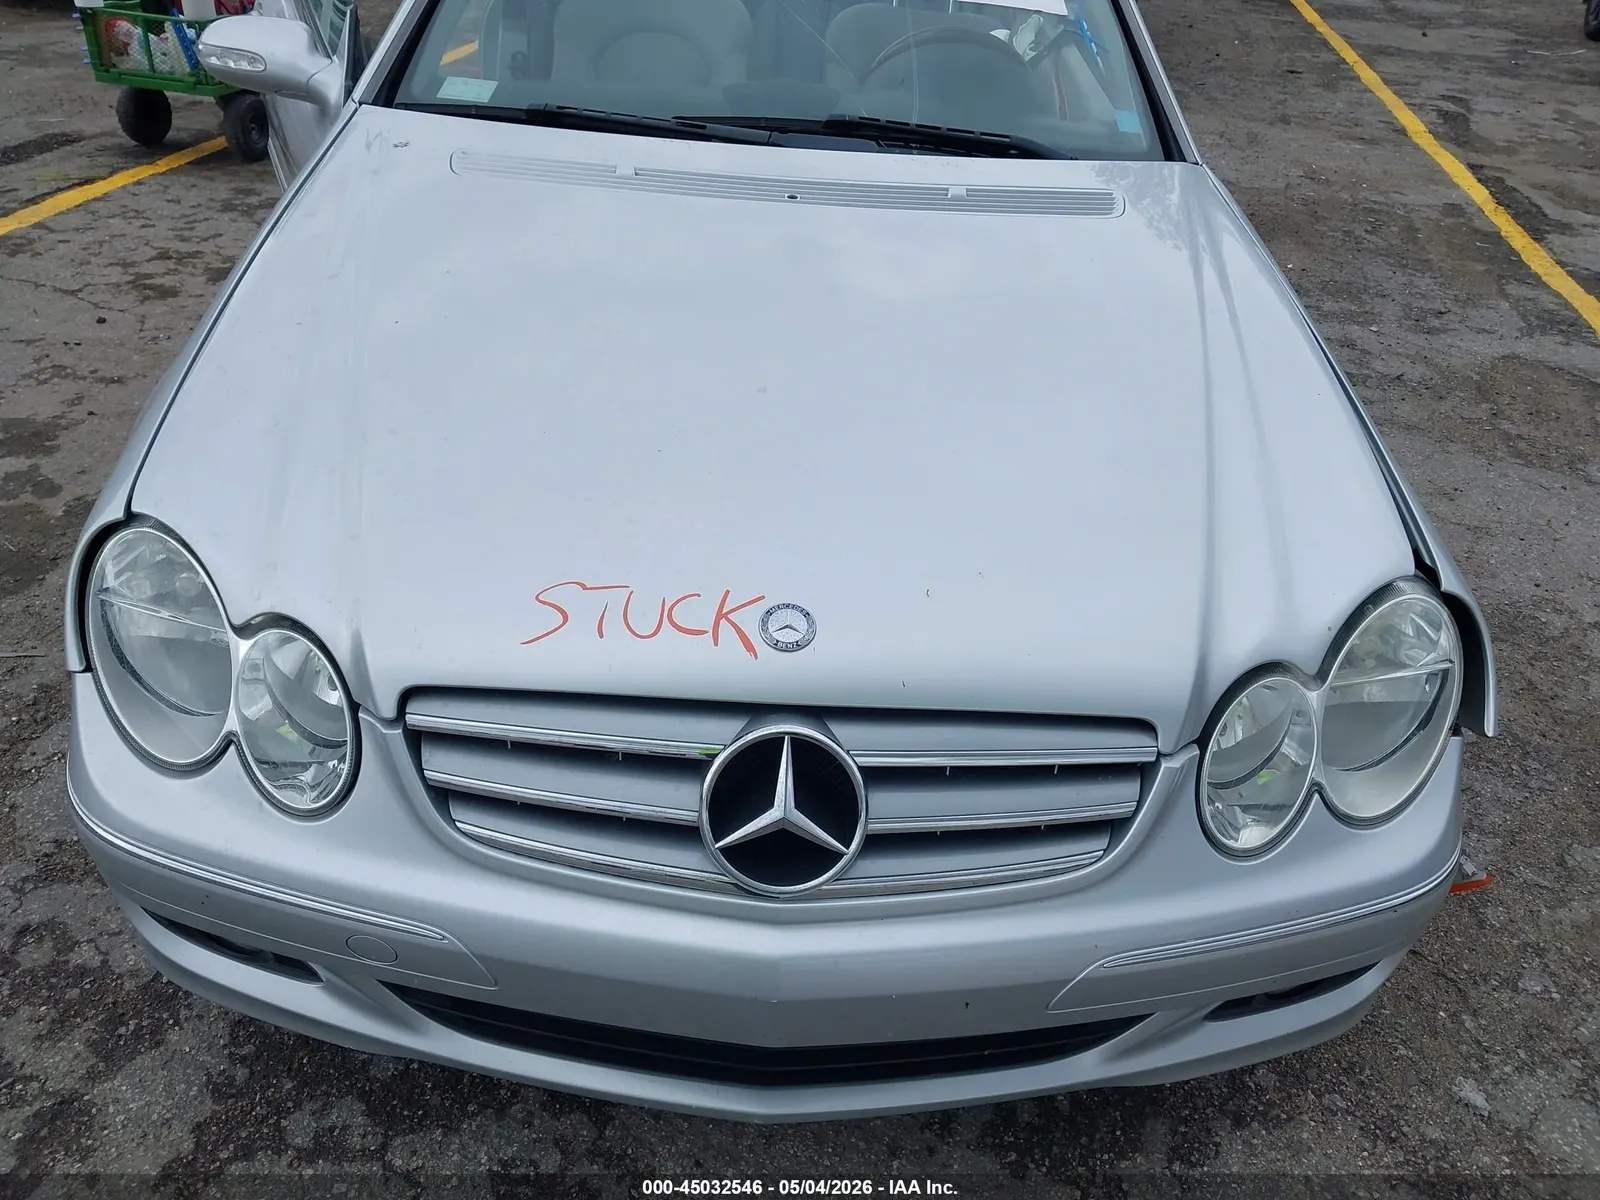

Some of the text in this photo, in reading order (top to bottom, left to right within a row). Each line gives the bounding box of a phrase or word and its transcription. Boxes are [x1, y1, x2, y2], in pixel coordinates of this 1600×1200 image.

[768, 603, 808, 617] MERCEDES
[519, 581, 765, 660] STUCK
[777, 641, 798, 649] BENZ
